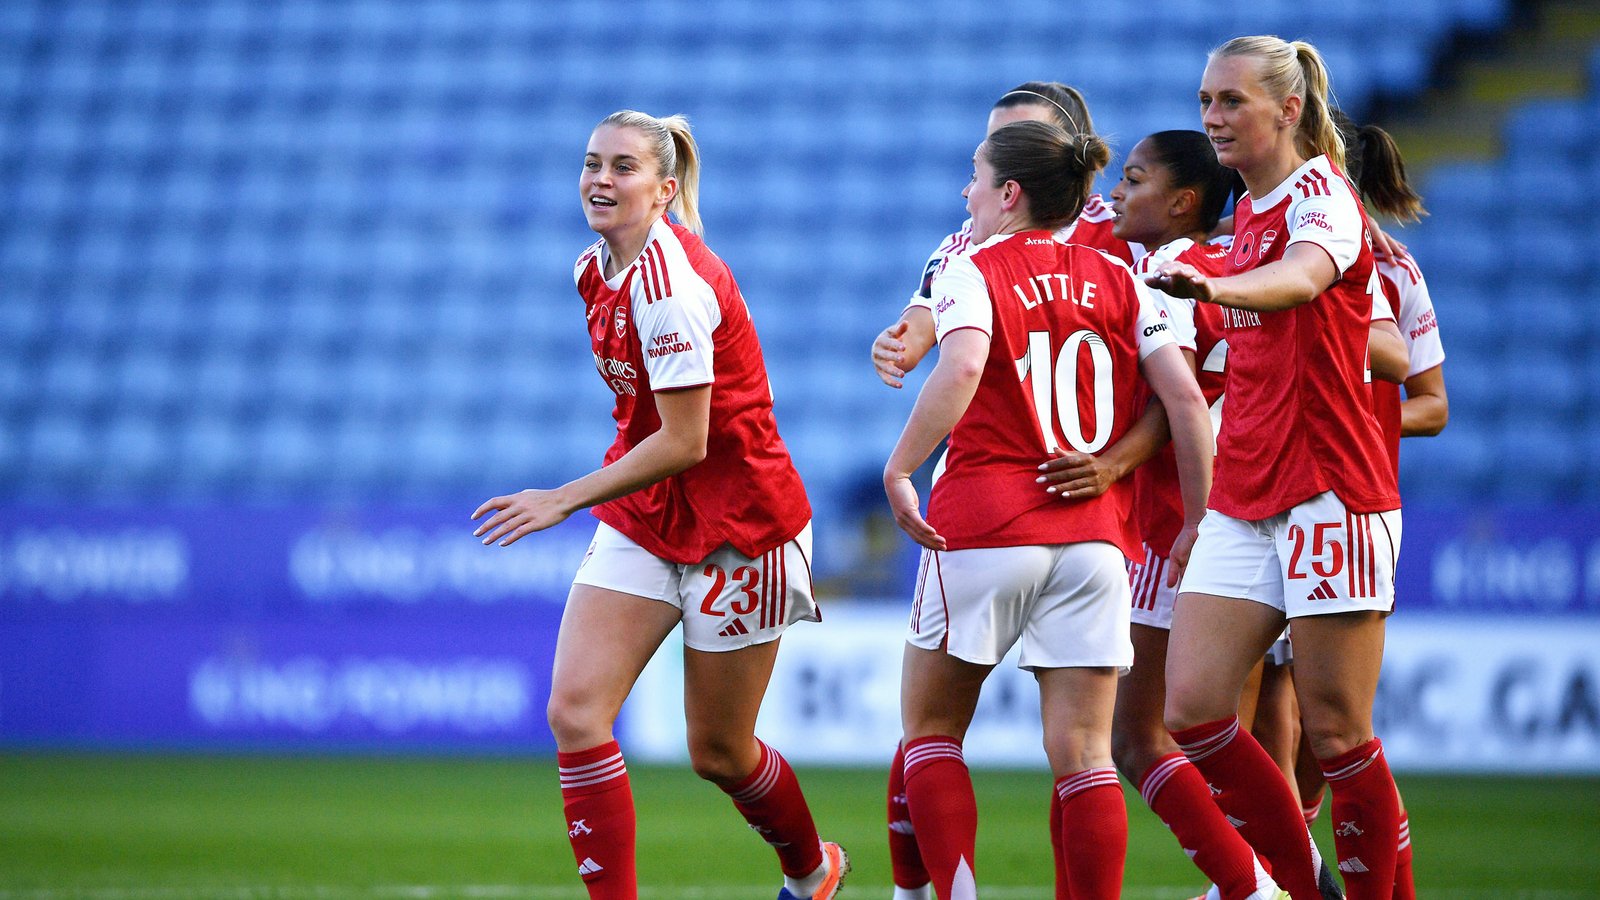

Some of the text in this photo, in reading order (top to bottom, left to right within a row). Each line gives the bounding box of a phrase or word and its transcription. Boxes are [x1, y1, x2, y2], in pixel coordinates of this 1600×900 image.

[1301, 212, 1328, 221] VISIT
[1013, 273, 1097, 311] LITTLE
[647, 341, 693, 359] RWANDA
[652, 332, 679, 347] VISIT
[1014, 329, 1115, 455] 10
[1287, 522, 1344, 580] 25
[700, 563, 760, 617] 23
